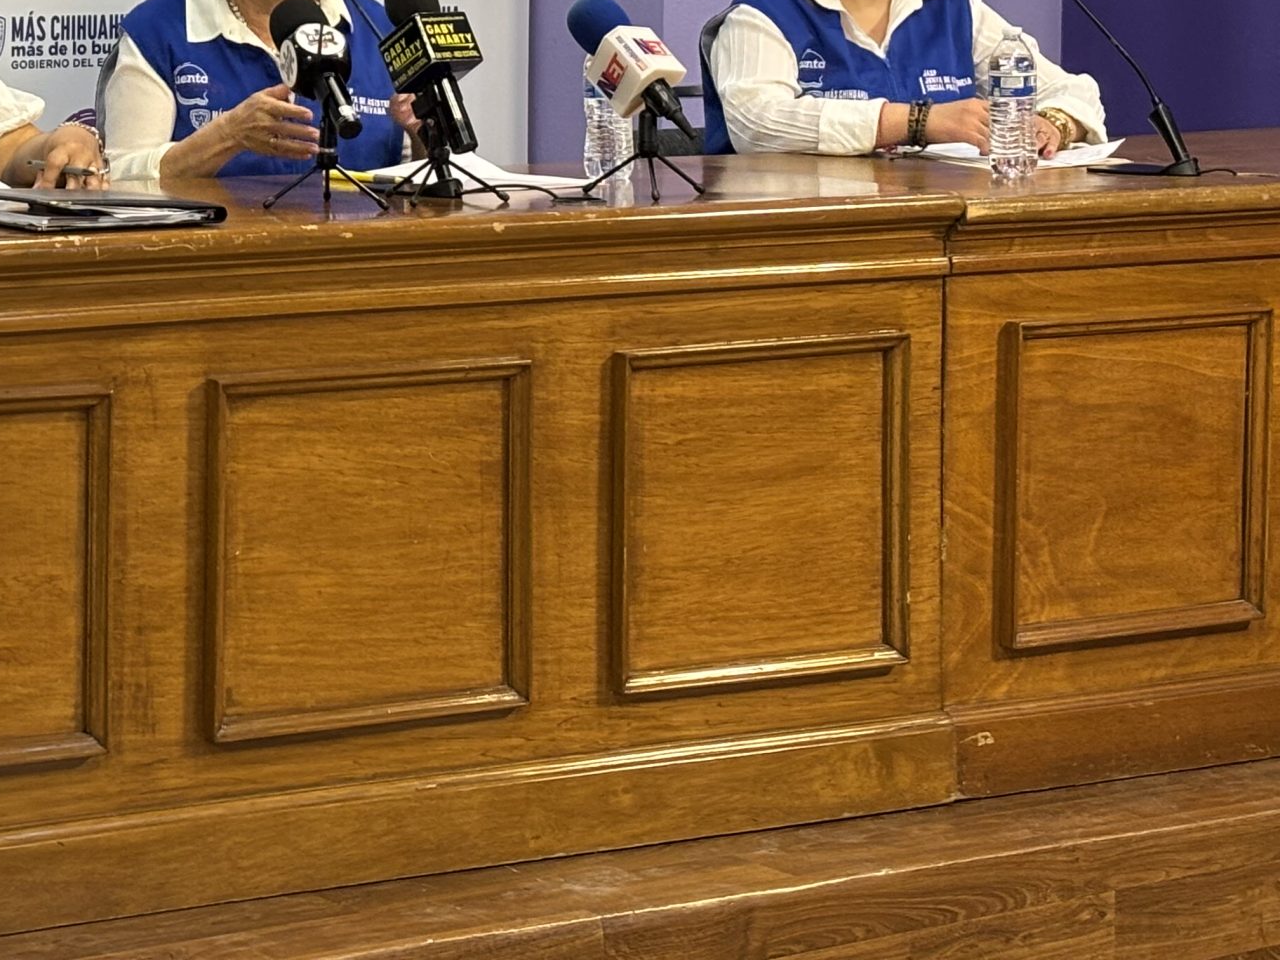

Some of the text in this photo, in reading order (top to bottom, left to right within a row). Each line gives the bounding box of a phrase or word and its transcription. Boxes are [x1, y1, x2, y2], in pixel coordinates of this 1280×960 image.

[425, 23, 454, 35] GABY
[435, 33, 472, 45] MARTY
[384, 37, 407, 63] GABY
[392, 39, 422, 70] MARTY
